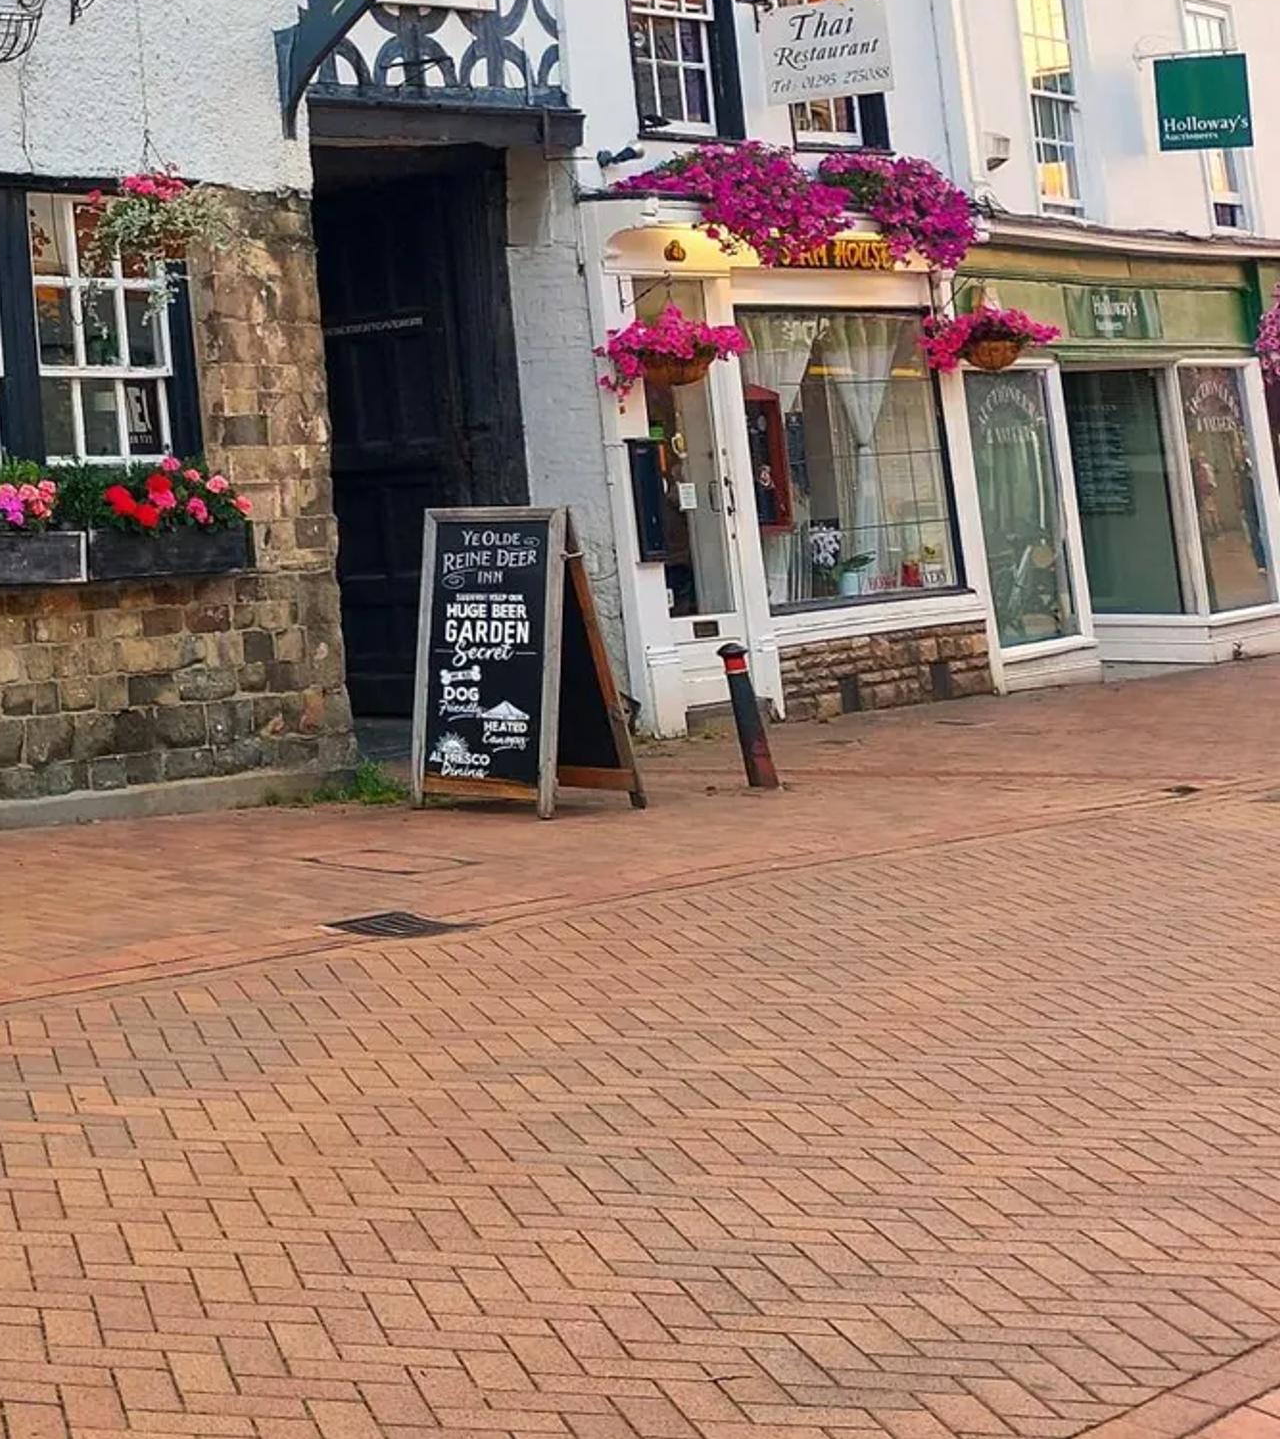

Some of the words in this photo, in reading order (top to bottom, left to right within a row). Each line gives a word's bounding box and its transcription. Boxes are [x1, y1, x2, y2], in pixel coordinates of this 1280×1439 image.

[790, 7, 855, 42] Thai
[773, 38, 880, 71] Restaurant
[1162, 114, 1249, 134] Holloway's
[443, 550, 492, 574] REINE
[496, 549, 537, 567] DEER
[477, 571, 503, 584] INN
[446, 603, 488, 618] HUGE
[491, 603, 527, 619] BEER
[445, 620, 530, 644] GARDEN
[451, 640, 515, 667] Secret
[443, 686, 480, 701] DOG
[483, 721, 528, 734] HEATED
